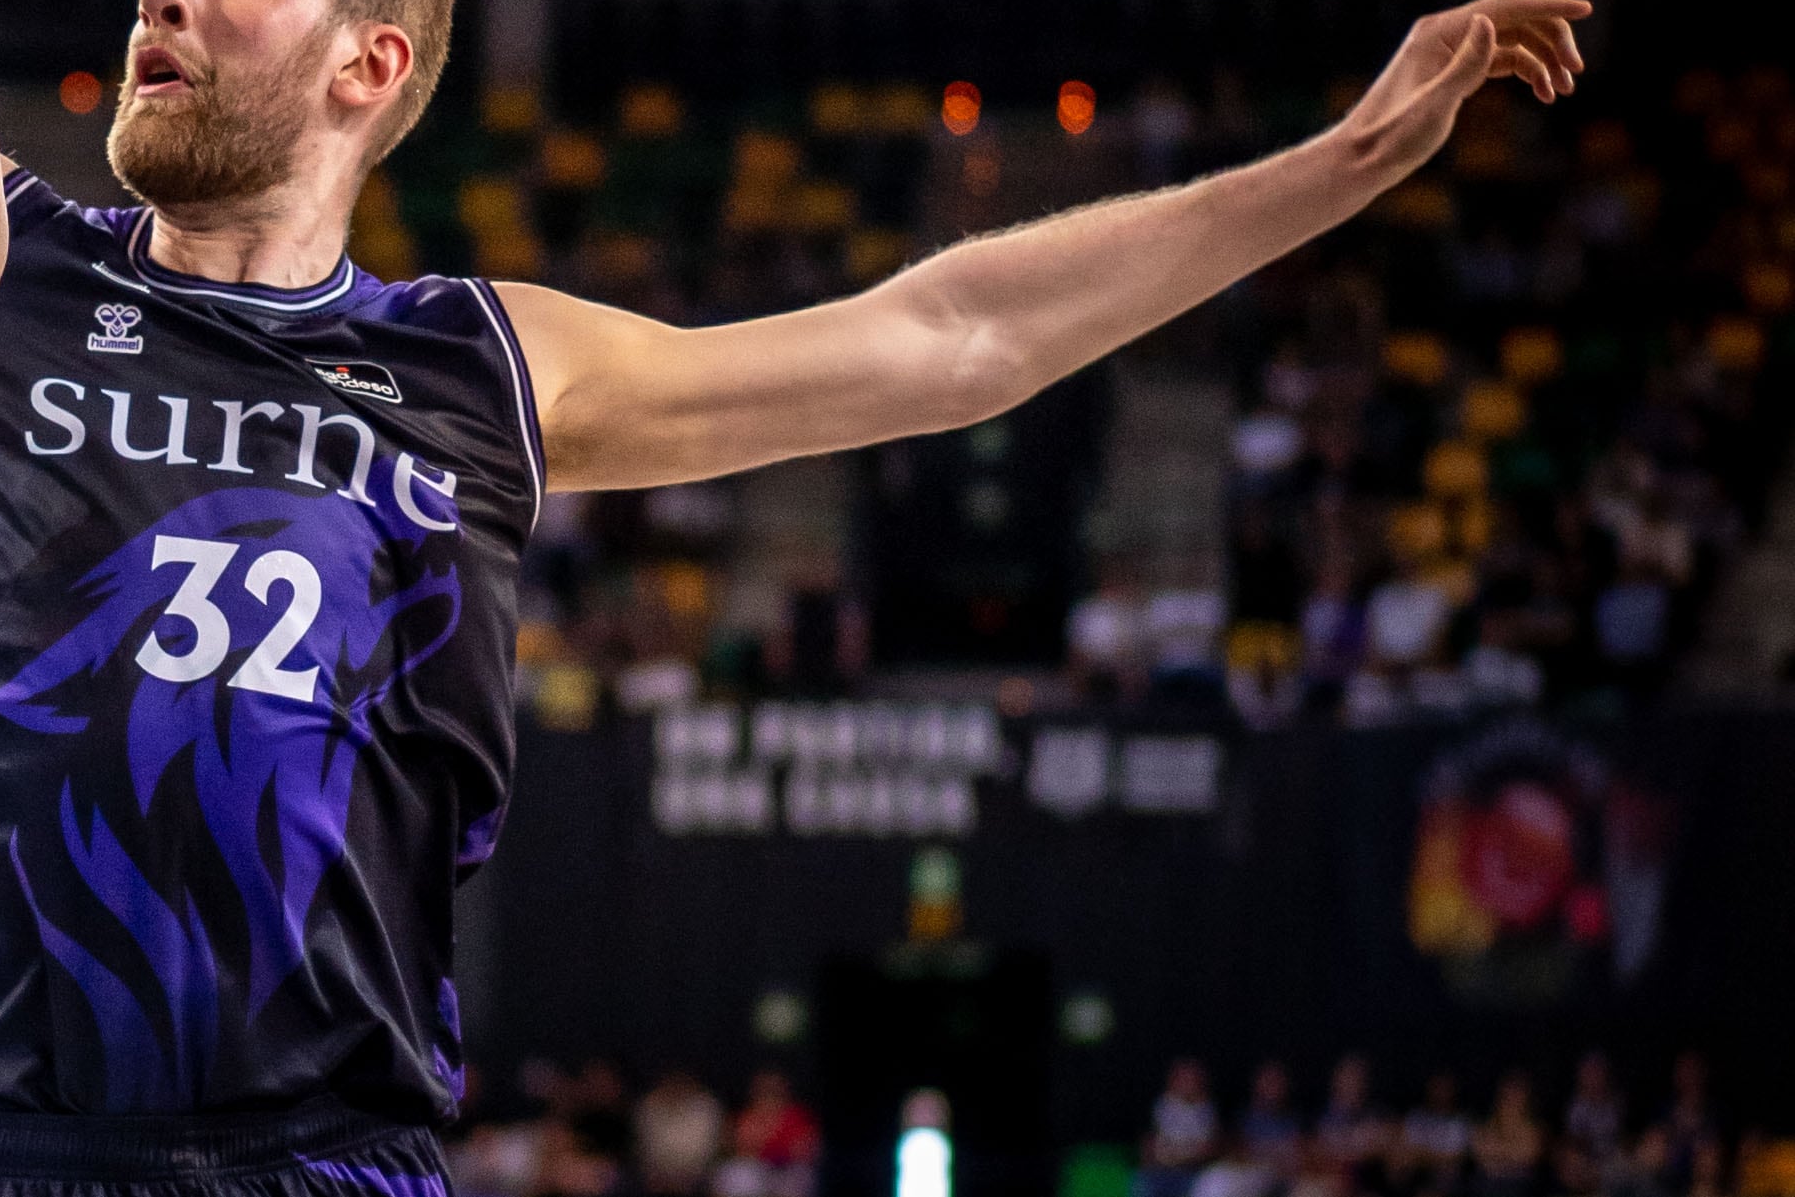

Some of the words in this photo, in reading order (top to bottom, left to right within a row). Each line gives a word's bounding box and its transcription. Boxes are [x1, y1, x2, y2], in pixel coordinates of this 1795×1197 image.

[91, 335, 140, 350] hummel
[24, 377, 457, 532] surne
[134, 534, 323, 703] 32
